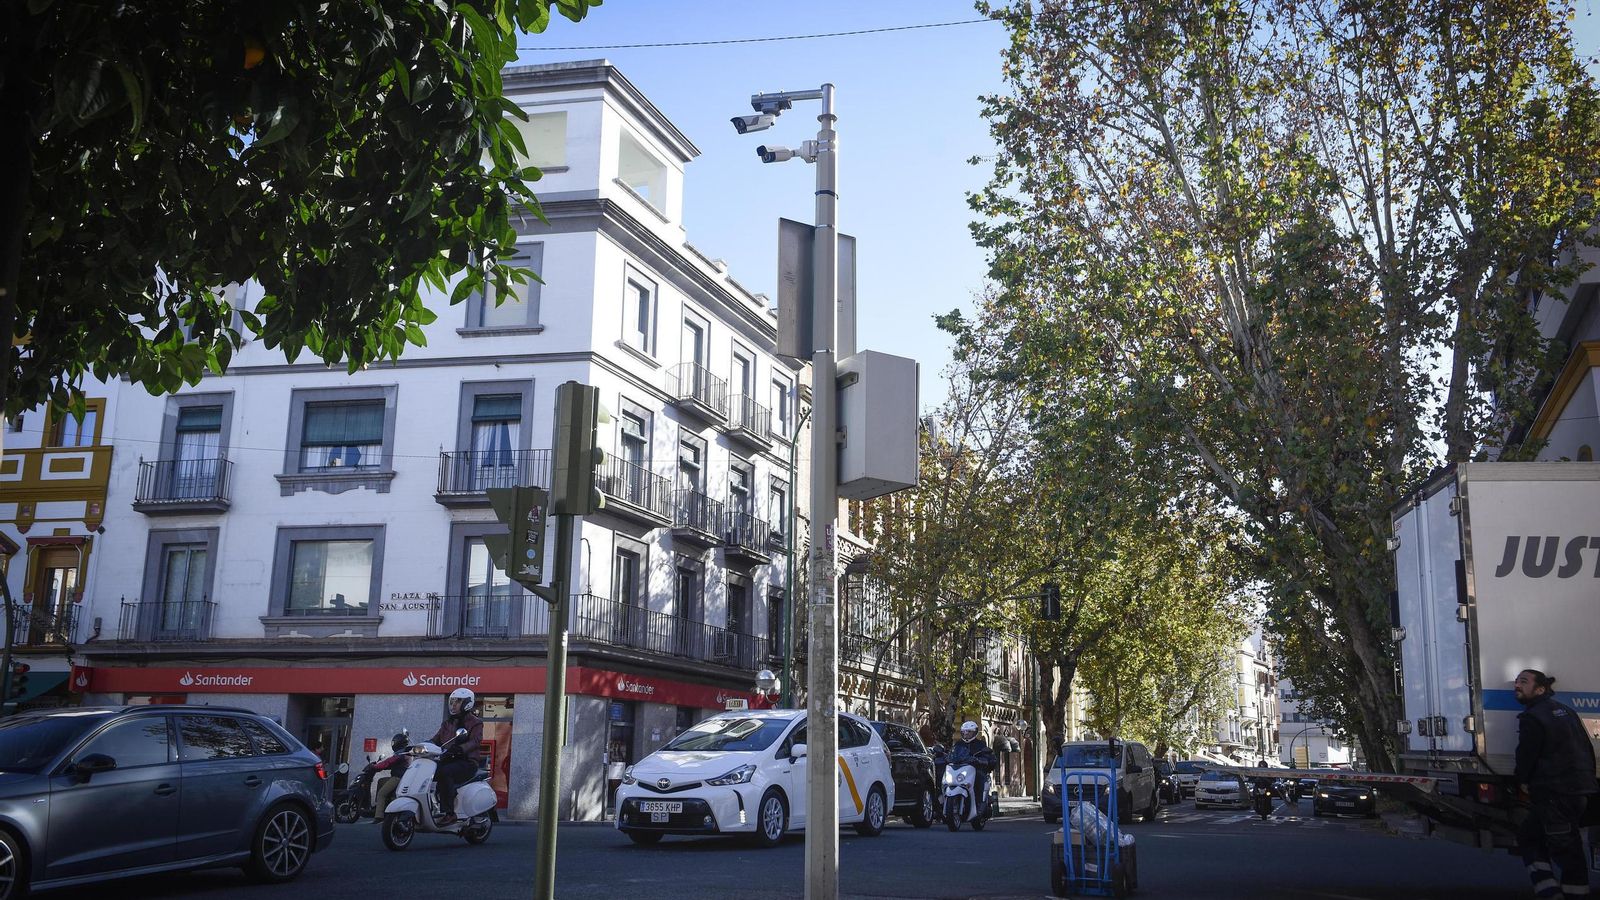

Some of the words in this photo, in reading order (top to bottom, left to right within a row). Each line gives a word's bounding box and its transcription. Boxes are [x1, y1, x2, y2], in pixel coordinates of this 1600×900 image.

[194, 674, 253, 686] Santander
[419, 674, 481, 686] Santander
[625, 680, 655, 695] Santander
[665, 803, 681, 812] KHP
